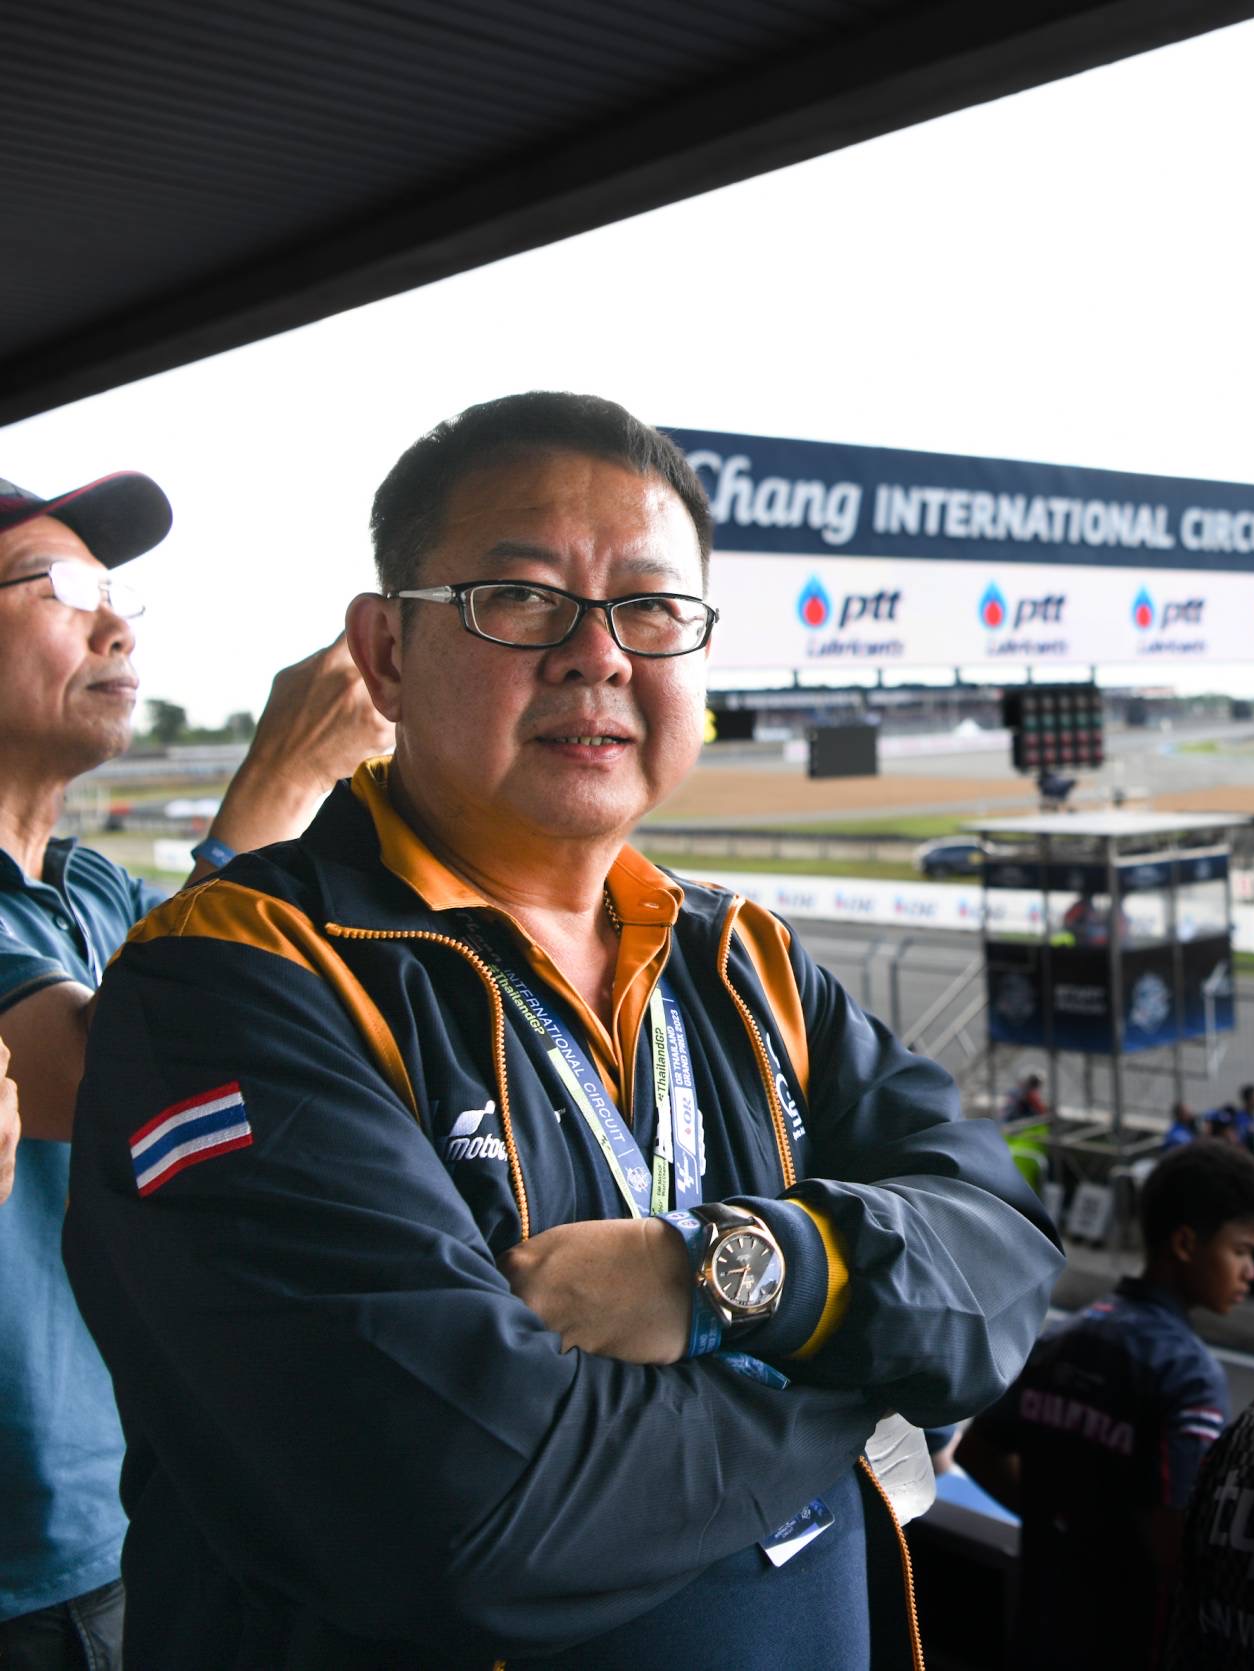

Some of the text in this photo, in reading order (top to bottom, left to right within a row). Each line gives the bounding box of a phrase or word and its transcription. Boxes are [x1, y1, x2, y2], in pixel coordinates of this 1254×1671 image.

[872, 484, 1175, 549] INTERNATIONAL
[838, 590, 902, 630] ptt
[1013, 594, 1067, 630] ptt
[1160, 598, 1206, 630] ptt
[504, 968, 584, 1077] INTERNATIONAL
[583, 1082, 626, 1143] CIRCUIT
[655, 1027, 667, 1101] #ThailandGP
[667, 1026, 681, 1071] THAILAND
[671, 1008, 692, 1087] GRAND PRIX 2023
